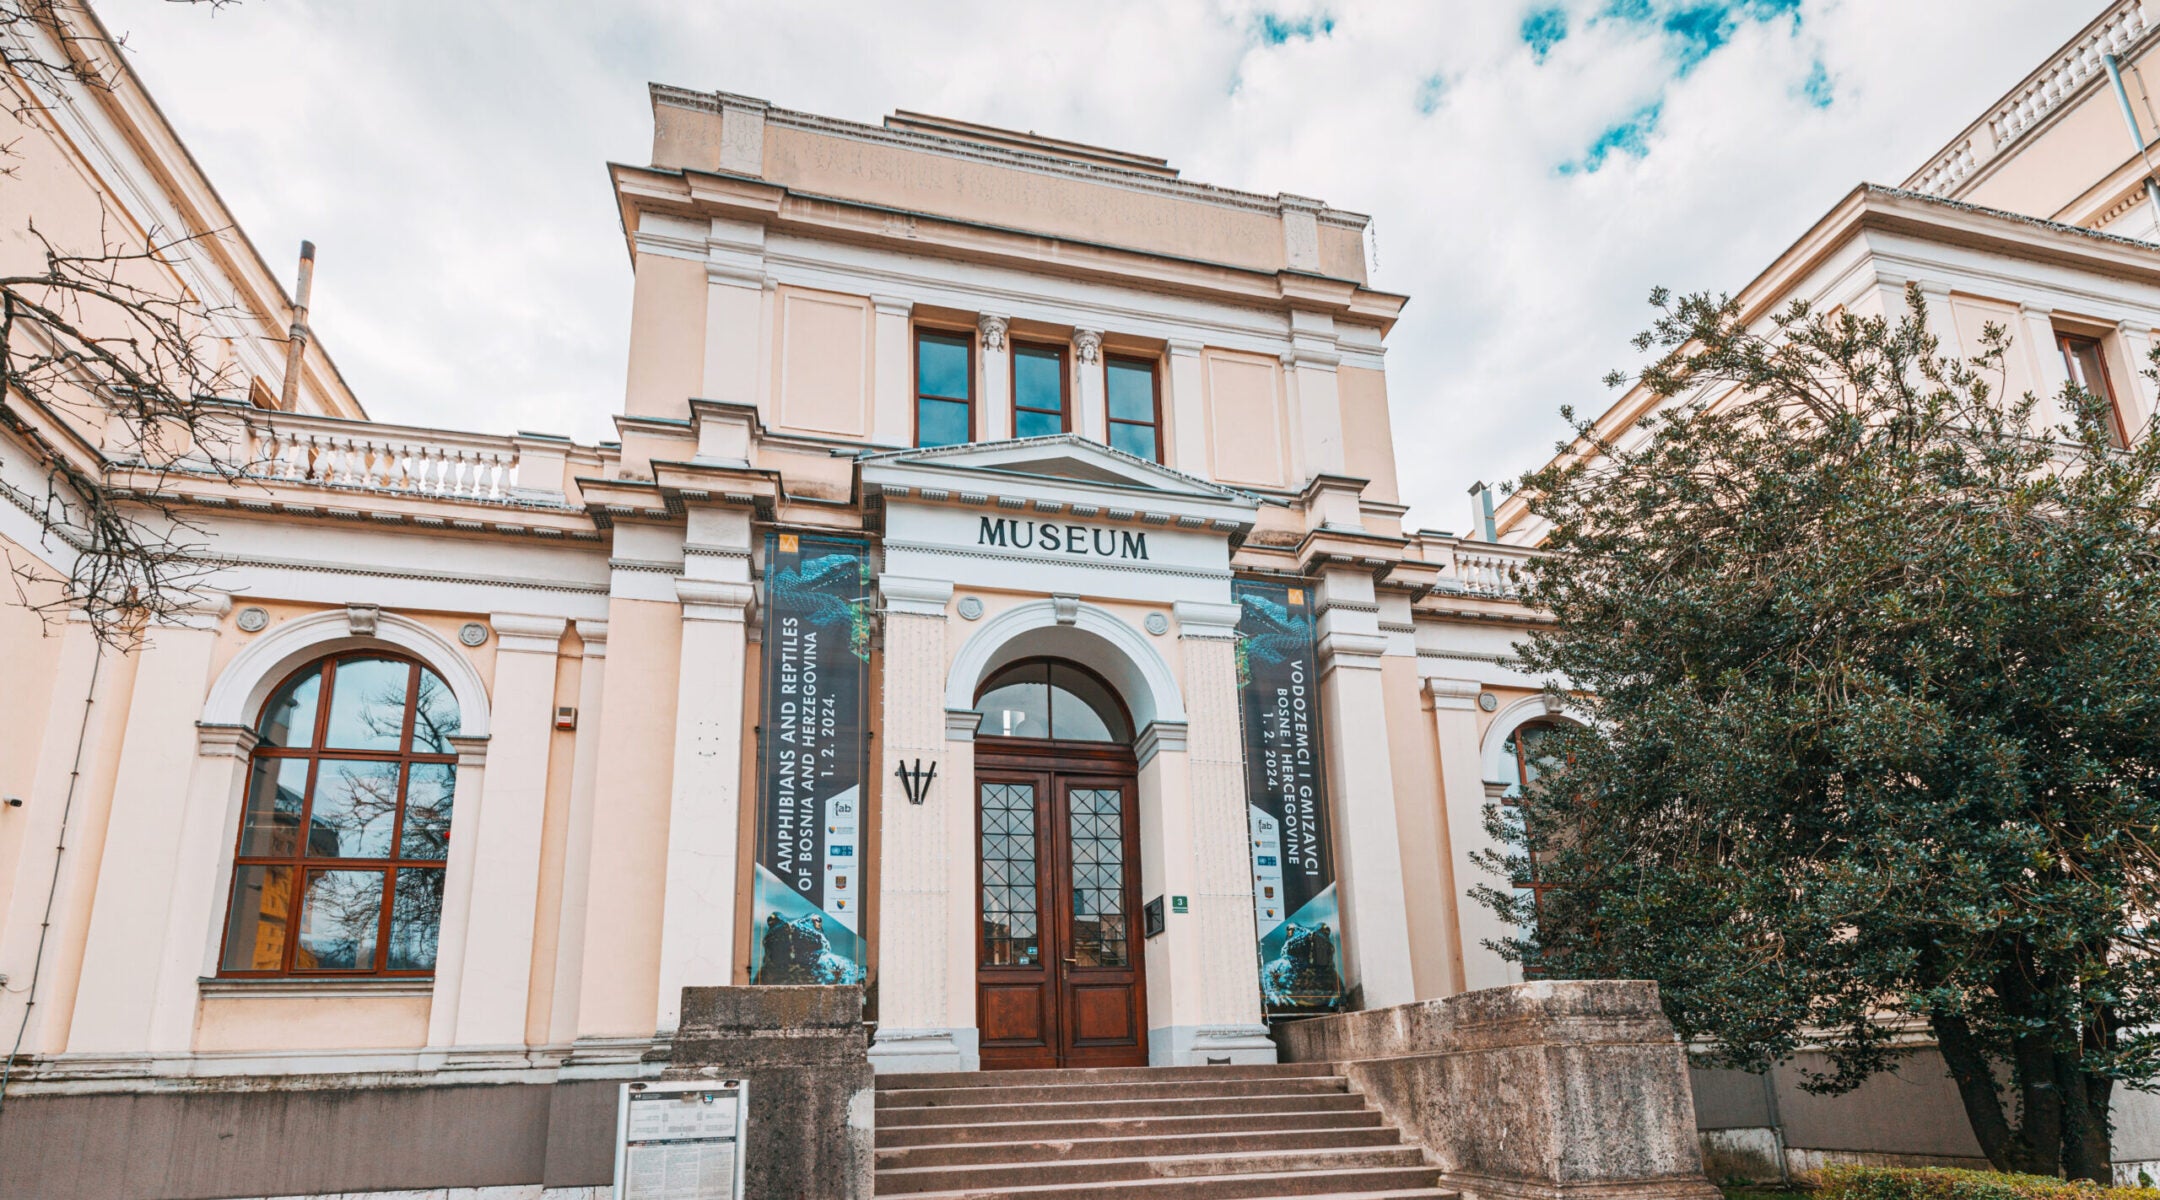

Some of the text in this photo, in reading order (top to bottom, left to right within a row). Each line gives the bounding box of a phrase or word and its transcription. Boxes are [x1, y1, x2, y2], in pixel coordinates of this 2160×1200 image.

[977, 516, 1149, 560] MUSEUM
[777, 617, 798, 873] AMPHIBIANS AND REPTILES
[821, 694, 836, 777] 1. 2. 2024.
[1263, 712, 1279, 791] 1. 2. 2024.
[1277, 688, 1291, 737] BOSNE
[1290, 660, 1310, 765] VODOZEMCI
[798, 632, 817, 891] OF BOSNIA AND HERZEGOVINA
[835, 801, 852, 816] fab
[1258, 819, 1273, 833] fab
[1281, 754, 1300, 865] HERCEGOVINE
[1299, 785, 1319, 876] GMIZAVCI
[1176, 898, 1184, 906] 3
